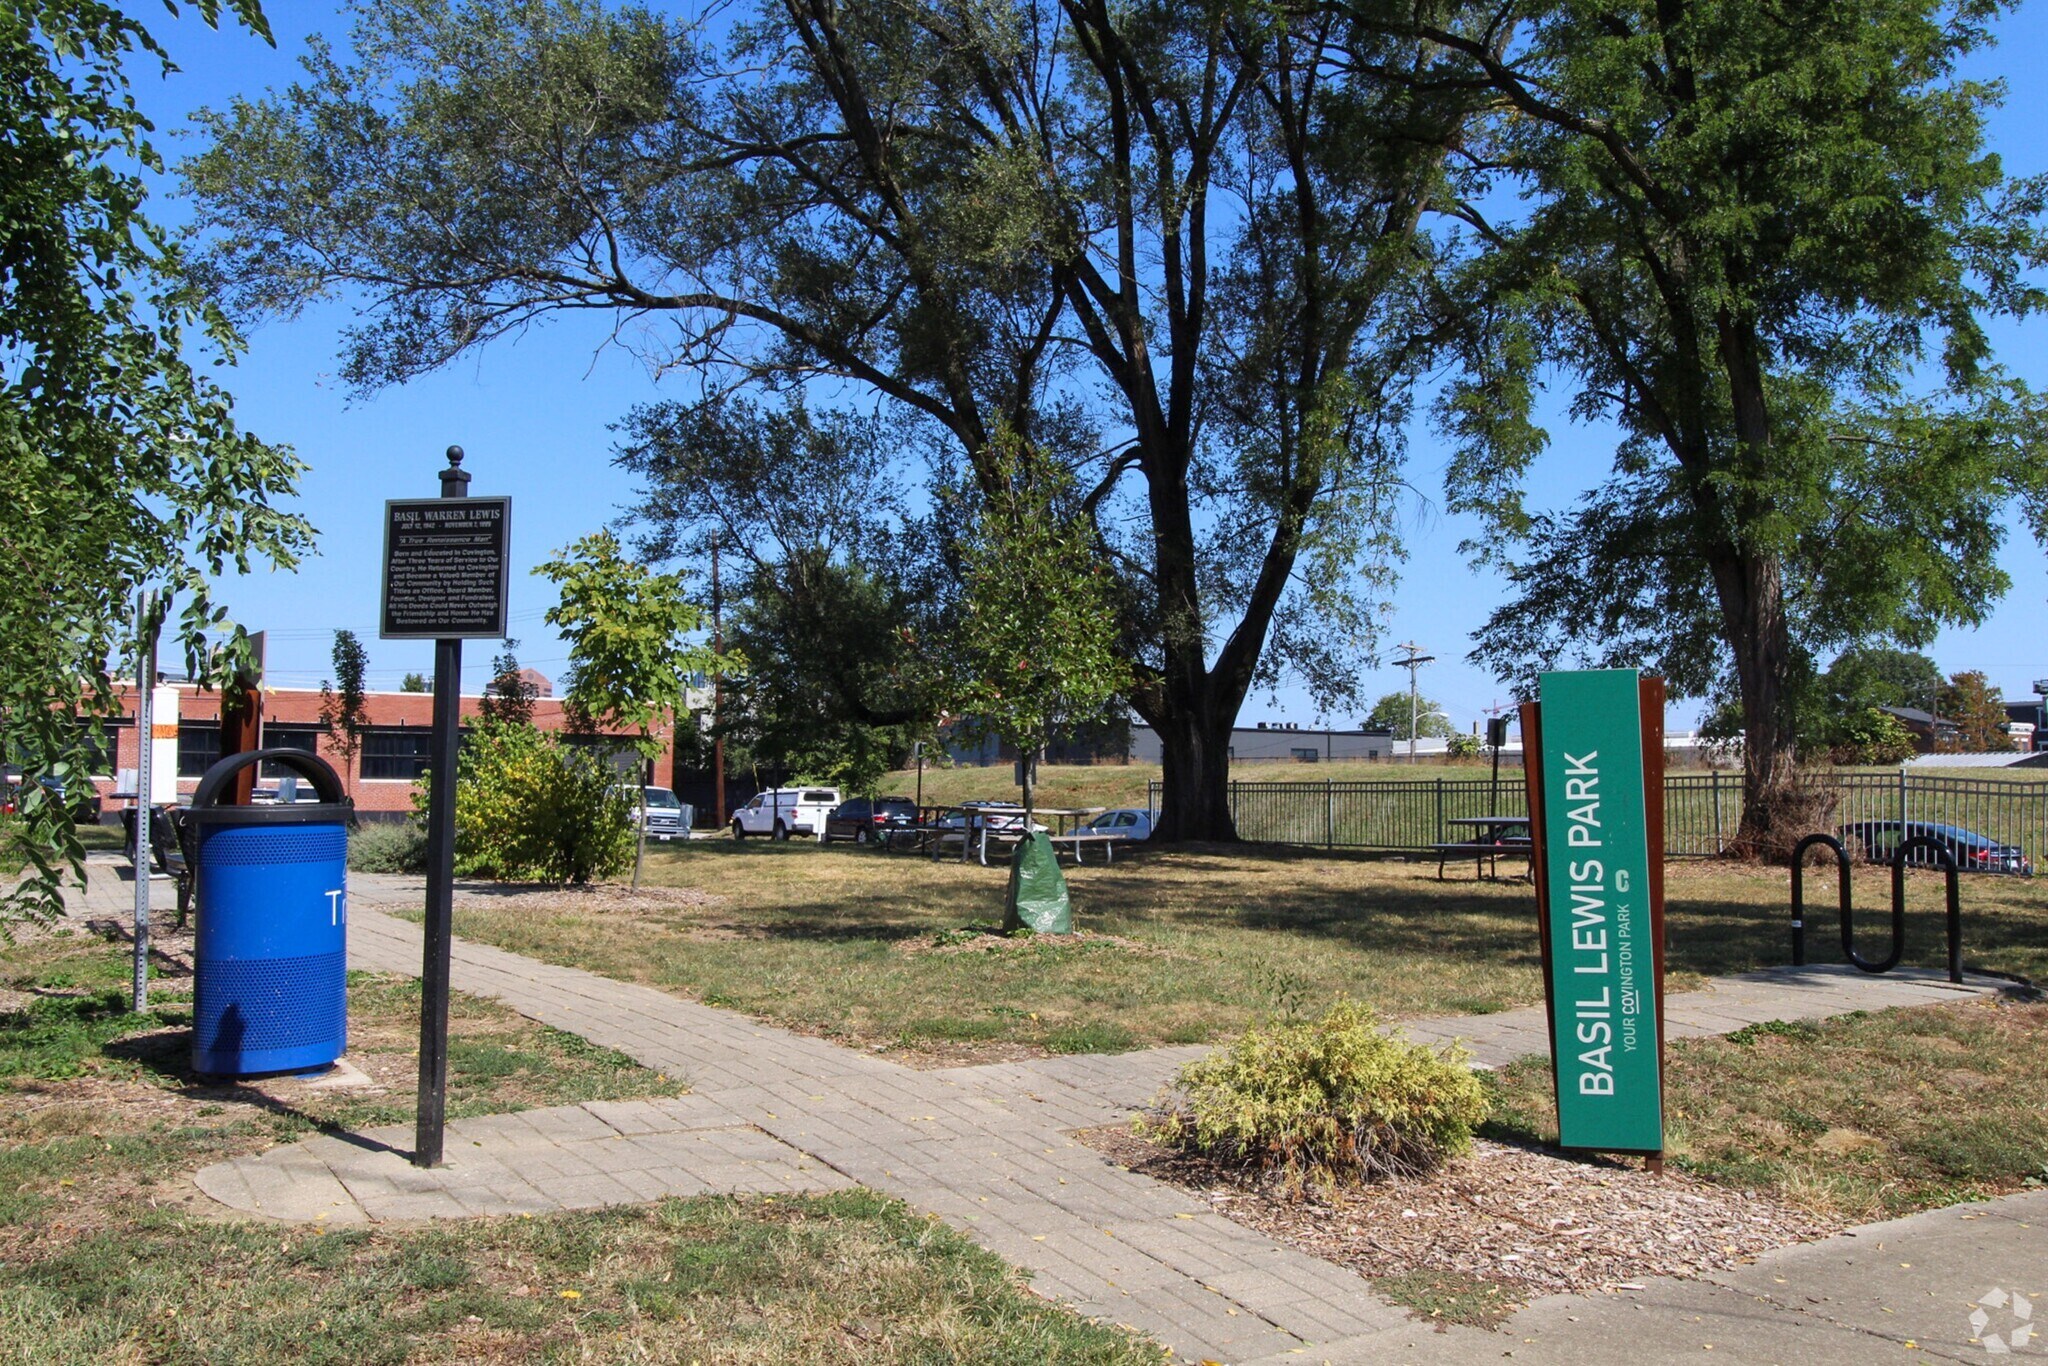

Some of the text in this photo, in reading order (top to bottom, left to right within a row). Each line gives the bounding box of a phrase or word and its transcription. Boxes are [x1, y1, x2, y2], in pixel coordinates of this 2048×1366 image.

[394, 509, 500, 522] BASIL WARREN LEWIS
[1564, 750, 1614, 1096] BASIL LEWIS PARK
[1616, 904, 1636, 1052] YOUR COVINGTON PARK
